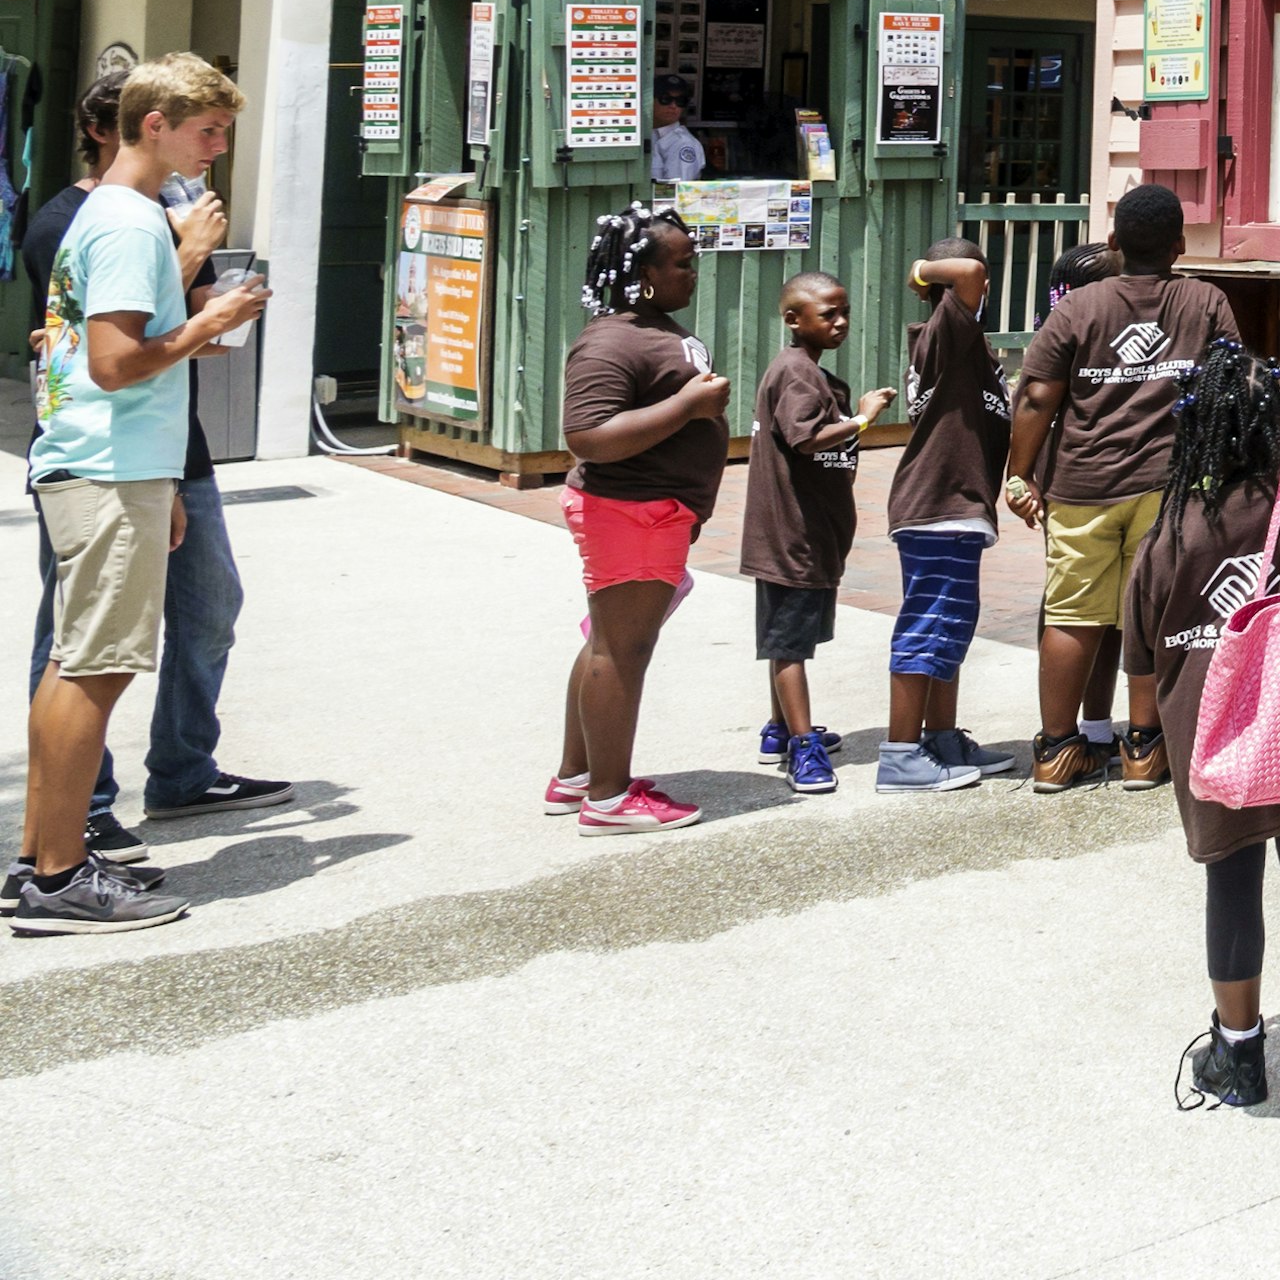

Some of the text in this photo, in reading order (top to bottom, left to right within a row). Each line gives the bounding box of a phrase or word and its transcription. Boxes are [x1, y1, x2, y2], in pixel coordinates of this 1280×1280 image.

[1078, 360, 1195, 378] BOYS & GIRLS CLUBS
[1104, 374, 1148, 384] NORTHEAST
[1148, 370, 1180, 381] FLORIDA
[814, 452, 848, 460] BOYS &
[1164, 624, 1218, 648] BOYS &
